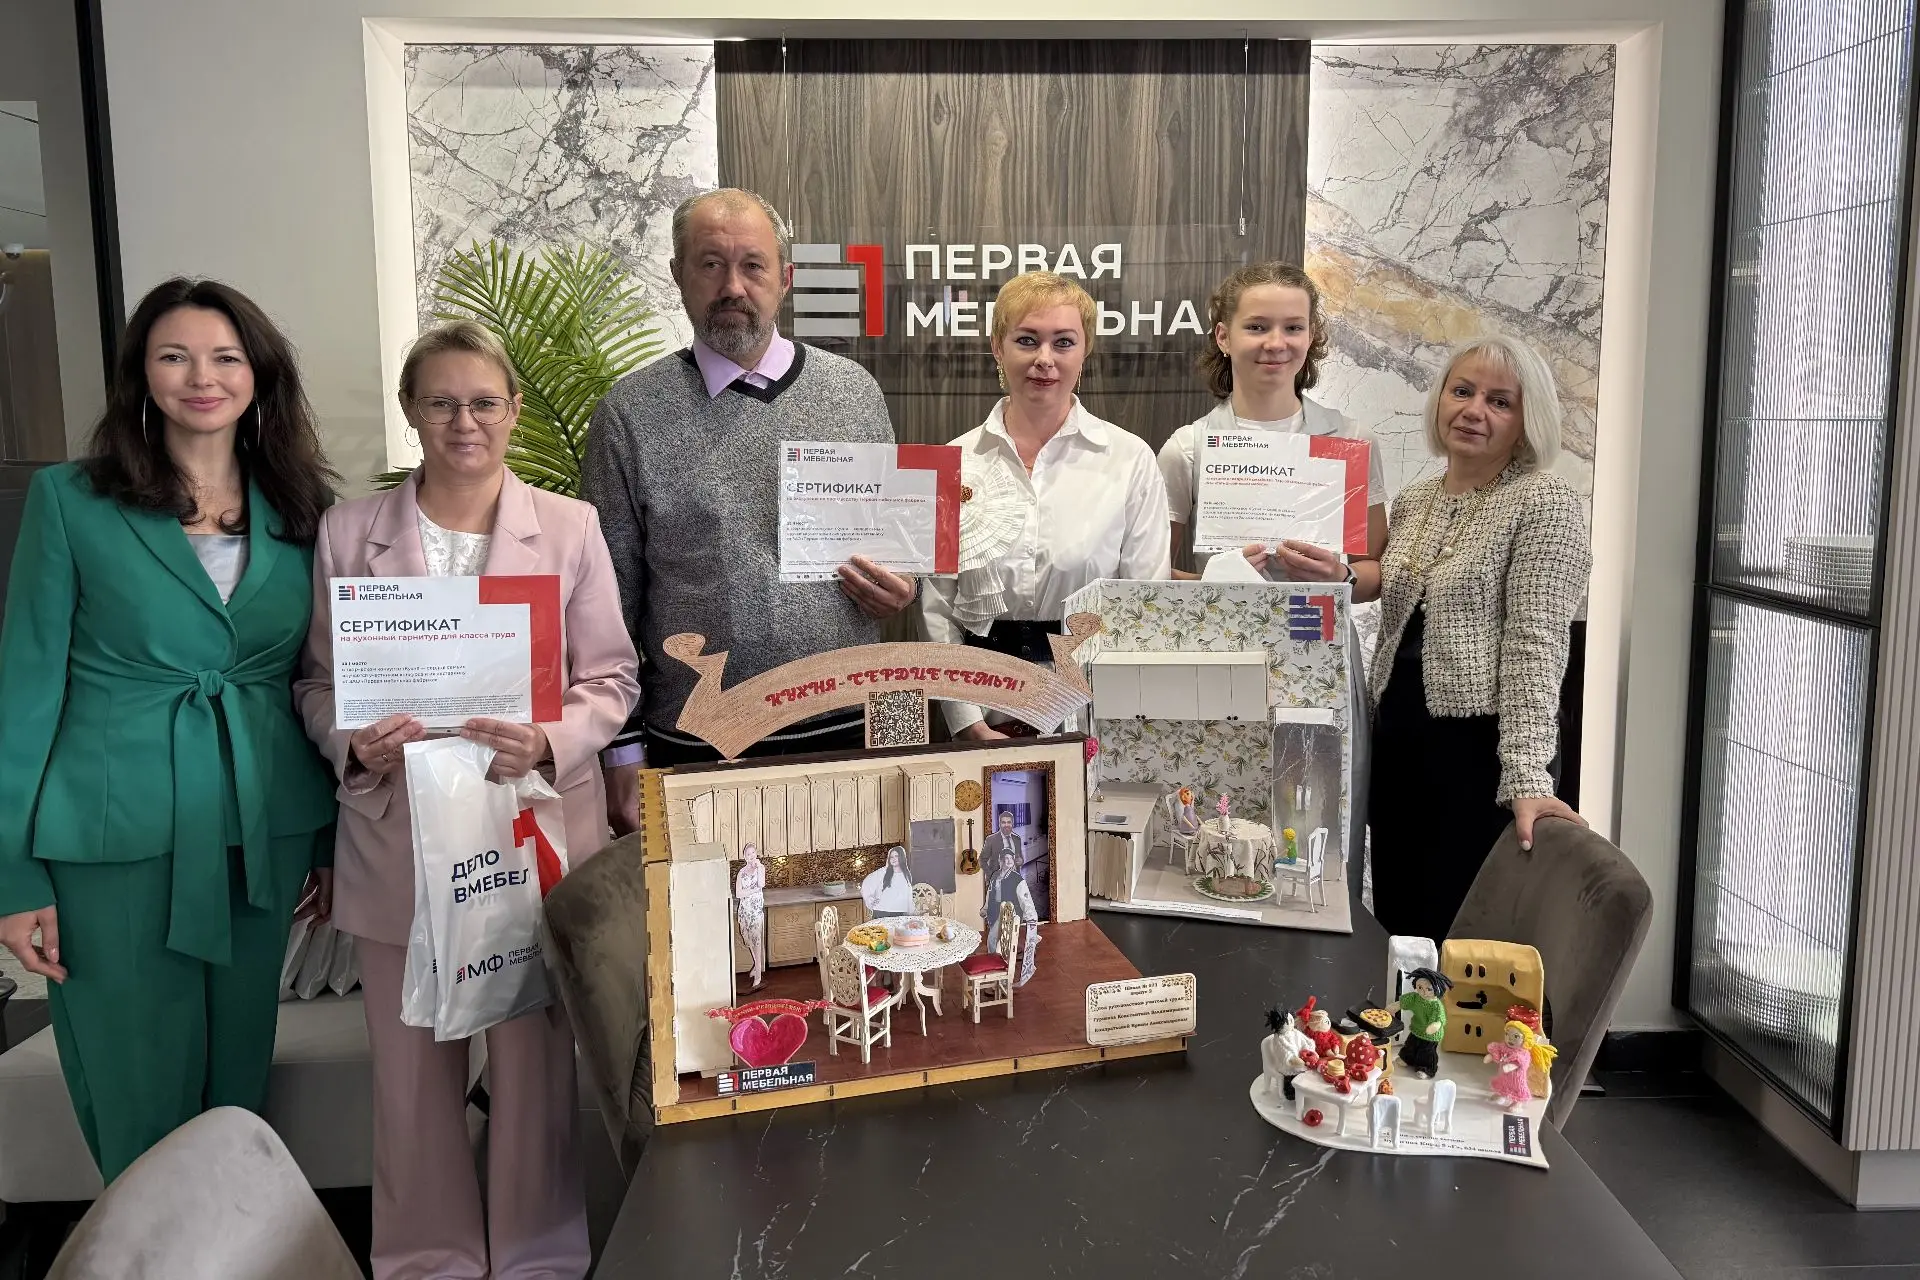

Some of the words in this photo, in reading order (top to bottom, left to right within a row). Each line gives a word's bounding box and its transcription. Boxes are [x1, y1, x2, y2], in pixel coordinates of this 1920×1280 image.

[905, 243, 1122, 279] ПЕРВАЯ
[905, 301, 1211, 337] МЕЬНА
[1205, 464, 1296, 477] СЕРТИФИКАТ
[786, 482, 882, 494] СЕРТИФИКАТ
[358, 584, 400, 592] ПЕРВАЯ
[359, 592, 423, 601] МЕБЕЛЬНАЯ
[339, 618, 461, 633] СЕРТИФИКАТ
[764, 678, 836, 707] КУХНЯ
[847, 667, 941, 686] СЕРДЦЕ
[944, 669, 1026, 693] СЕМЬИ!
[451, 850, 500, 882] ДЕЛО
[508, 942, 539, 958] ПЕРВАЯ
[742, 1065, 789, 1080] ПЕРВАЯ
[742, 1073, 814, 1091] МЕБЕЛЬНАЯ
